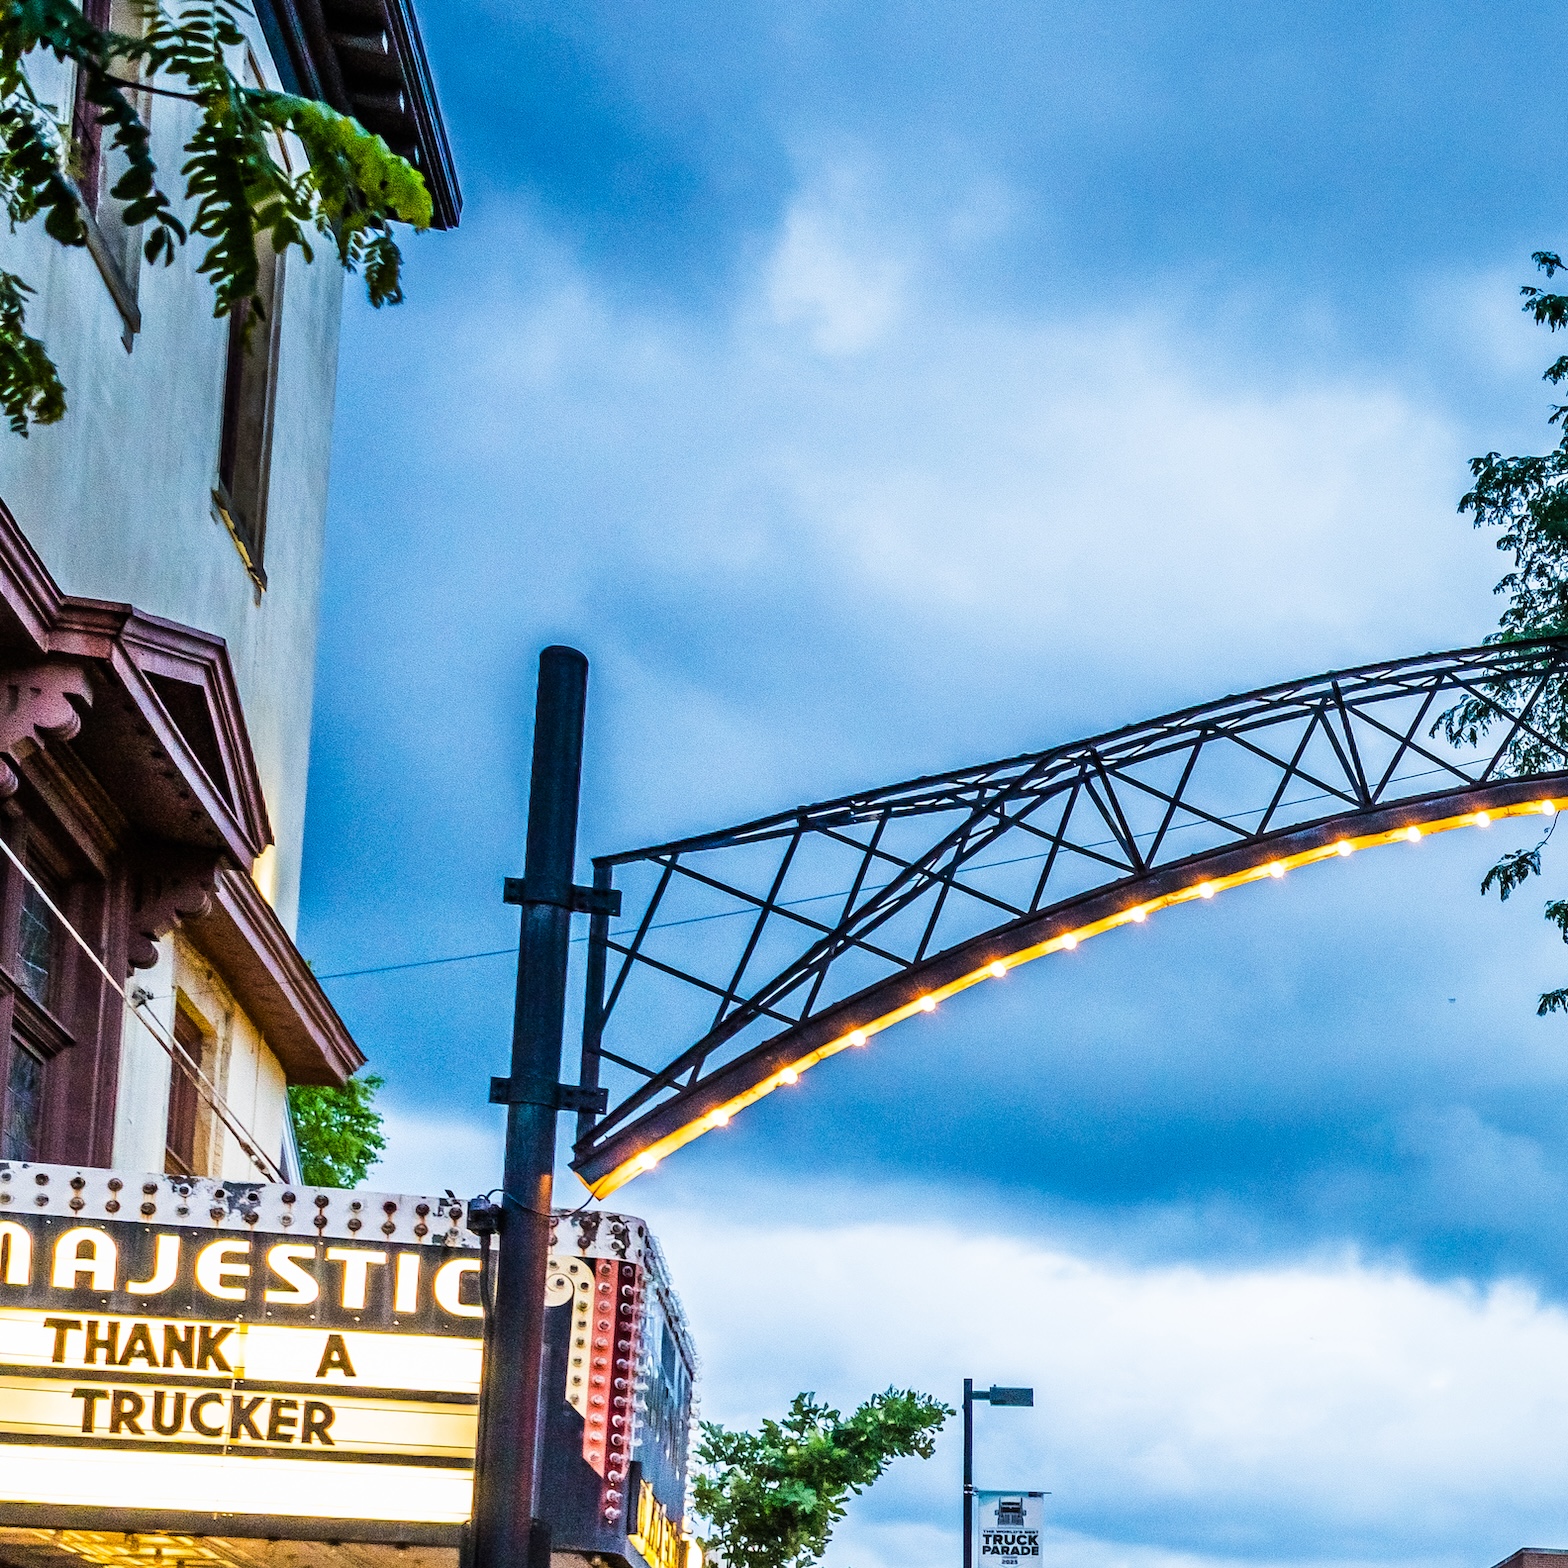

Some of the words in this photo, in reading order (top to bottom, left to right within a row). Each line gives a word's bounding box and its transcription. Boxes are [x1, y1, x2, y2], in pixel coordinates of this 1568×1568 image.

[43, 1317, 235, 1373] THANK
[315, 1334, 357, 1379] A
[71, 1387, 336, 1446] TRUCKER
[982, 1533, 1039, 1546] TRUCK
[982, 1546, 1039, 1556] PARADE
